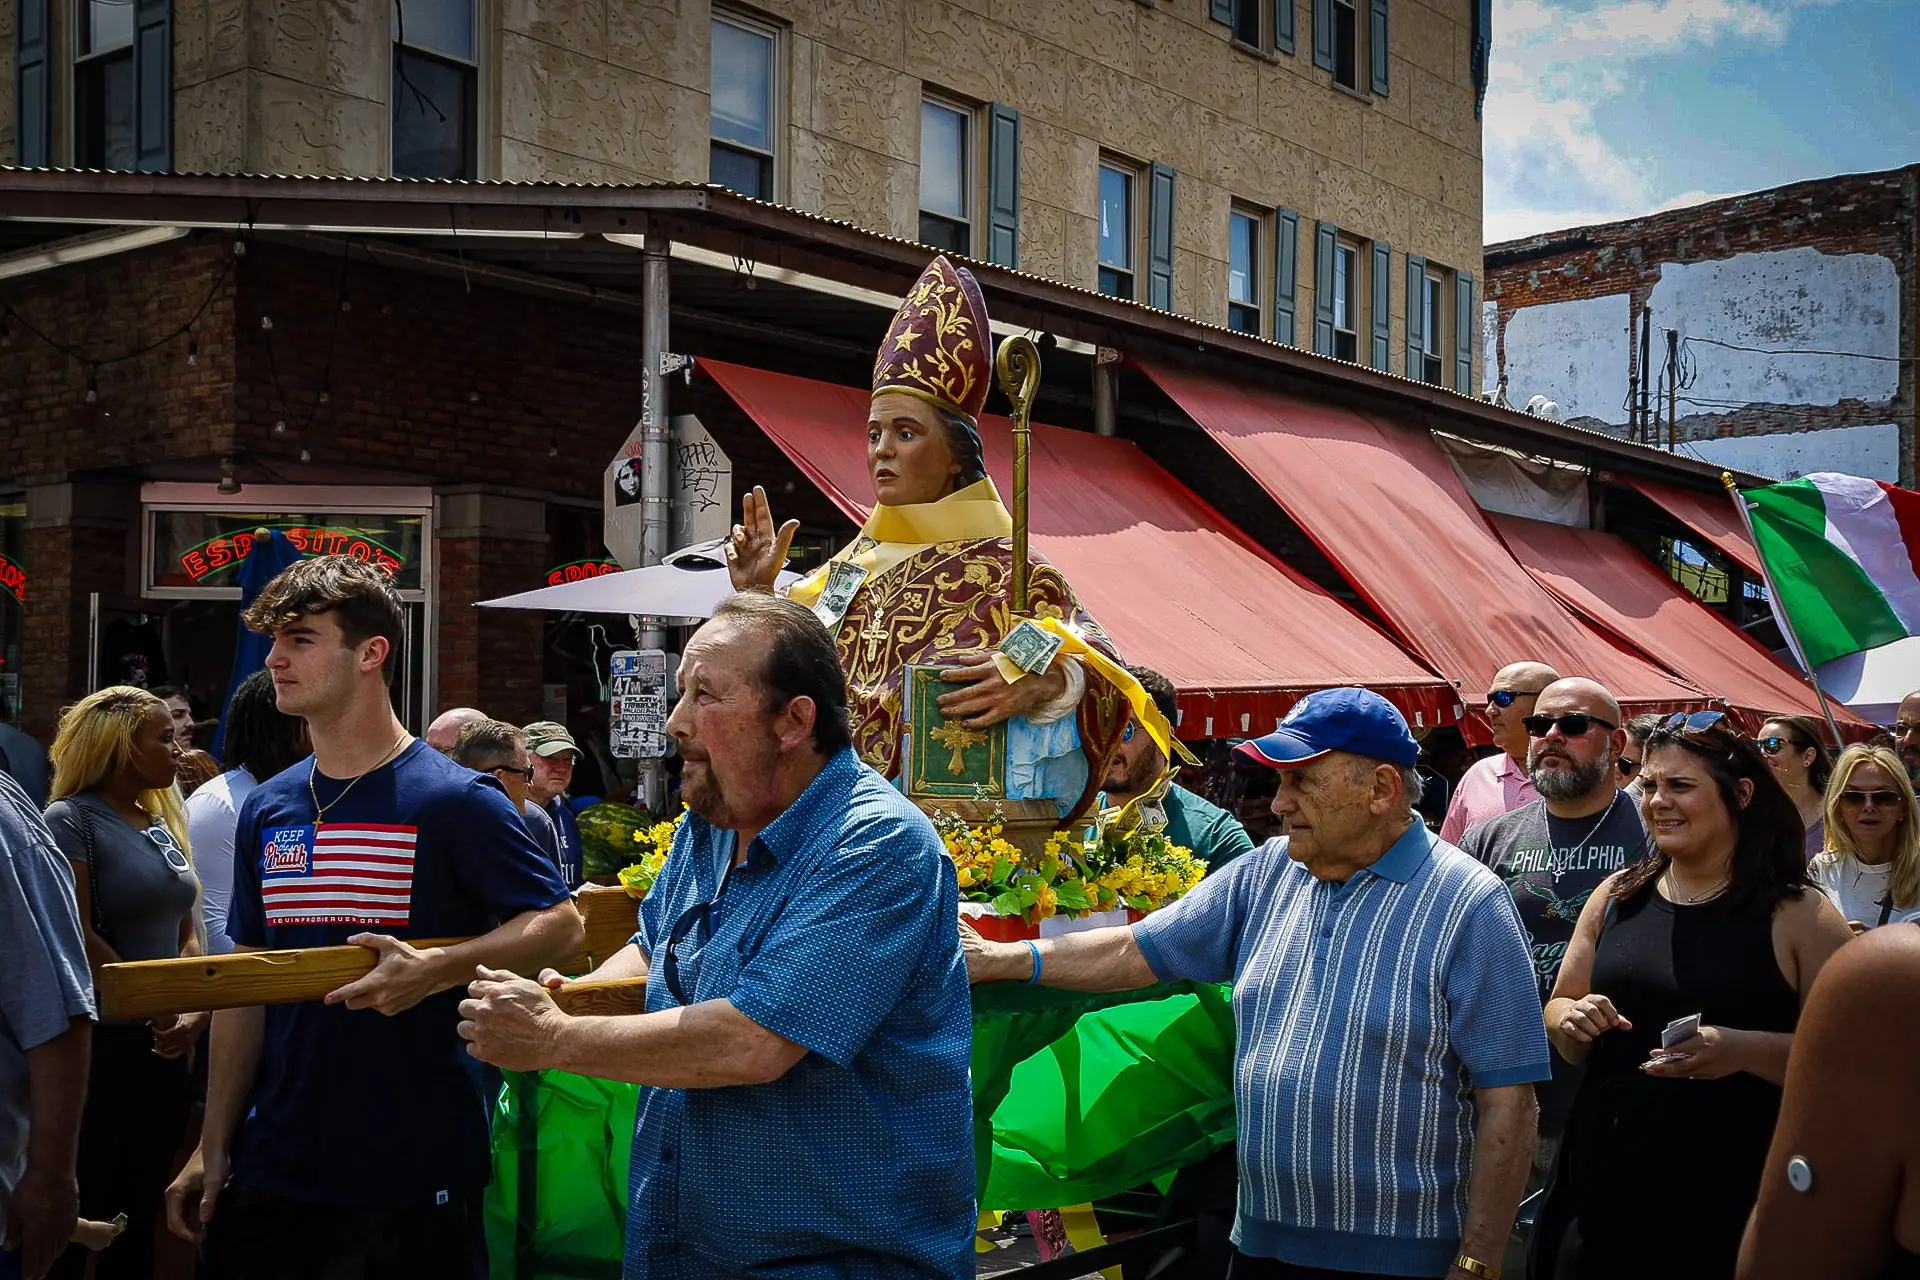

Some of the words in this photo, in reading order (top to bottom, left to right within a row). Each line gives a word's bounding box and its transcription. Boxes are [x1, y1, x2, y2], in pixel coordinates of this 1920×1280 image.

[180, 527, 400, 580] ESPSITO'S
[641, 731, 649, 744] 3
[274, 829, 305, 843] KEEP
[264, 841, 308, 869] Phaith
[1510, 845, 1626, 873] PHILADELPHIA
